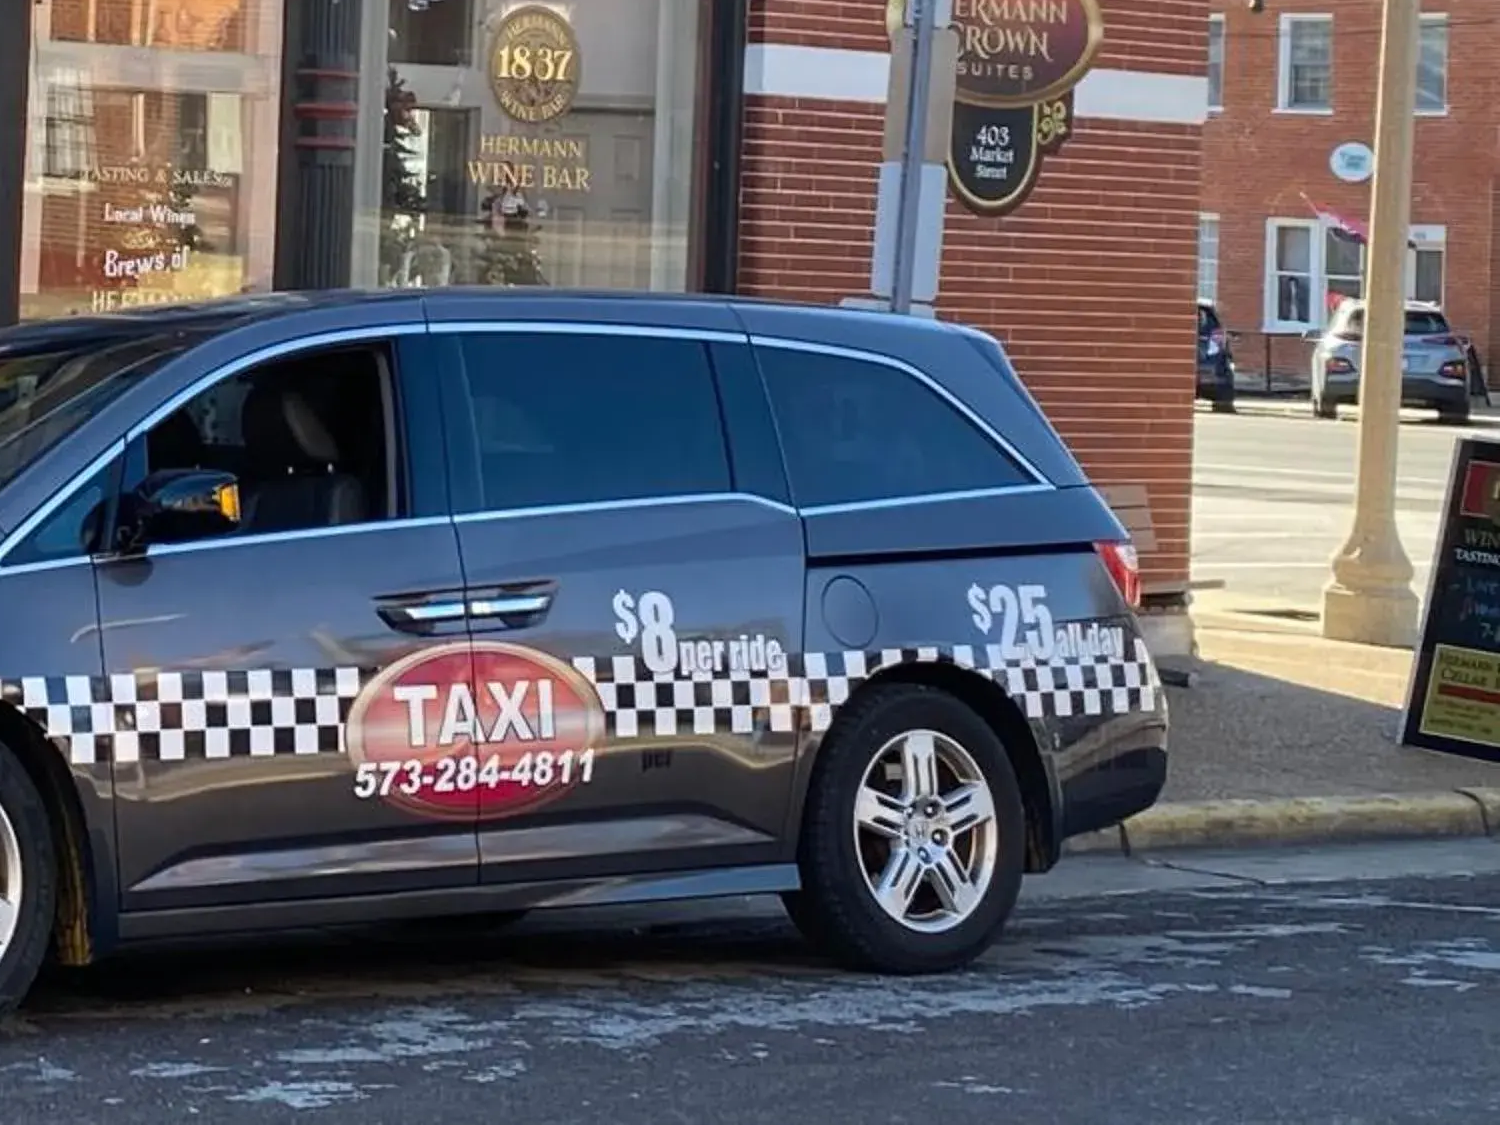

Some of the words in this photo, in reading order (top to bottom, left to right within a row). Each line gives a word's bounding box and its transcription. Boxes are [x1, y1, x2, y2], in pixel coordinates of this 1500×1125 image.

[498, 45, 573, 81] 1837
[956, 60, 1034, 81] SUITES
[500, 90, 537, 121] WINE
[480, 135, 583, 158] HERMANN
[976, 125, 1011, 146] 403
[969, 146, 1015, 164] Market
[84, 166, 149, 184] TASTING
[155, 168, 168, 184] &
[468, 160, 536, 189] WINE
[543, 165, 591, 191] BAR
[104, 202, 143, 222] Local
[104, 249, 165, 278] Brews
[171, 244, 191, 271] of
[612, 588, 679, 674] $8
[678, 639, 725, 676] per
[729, 634, 783, 672] ride
[967, 582, 1054, 661] $25
[393, 679, 557, 747] TAXI
[353, 749, 596, 799] 573-284-4811
